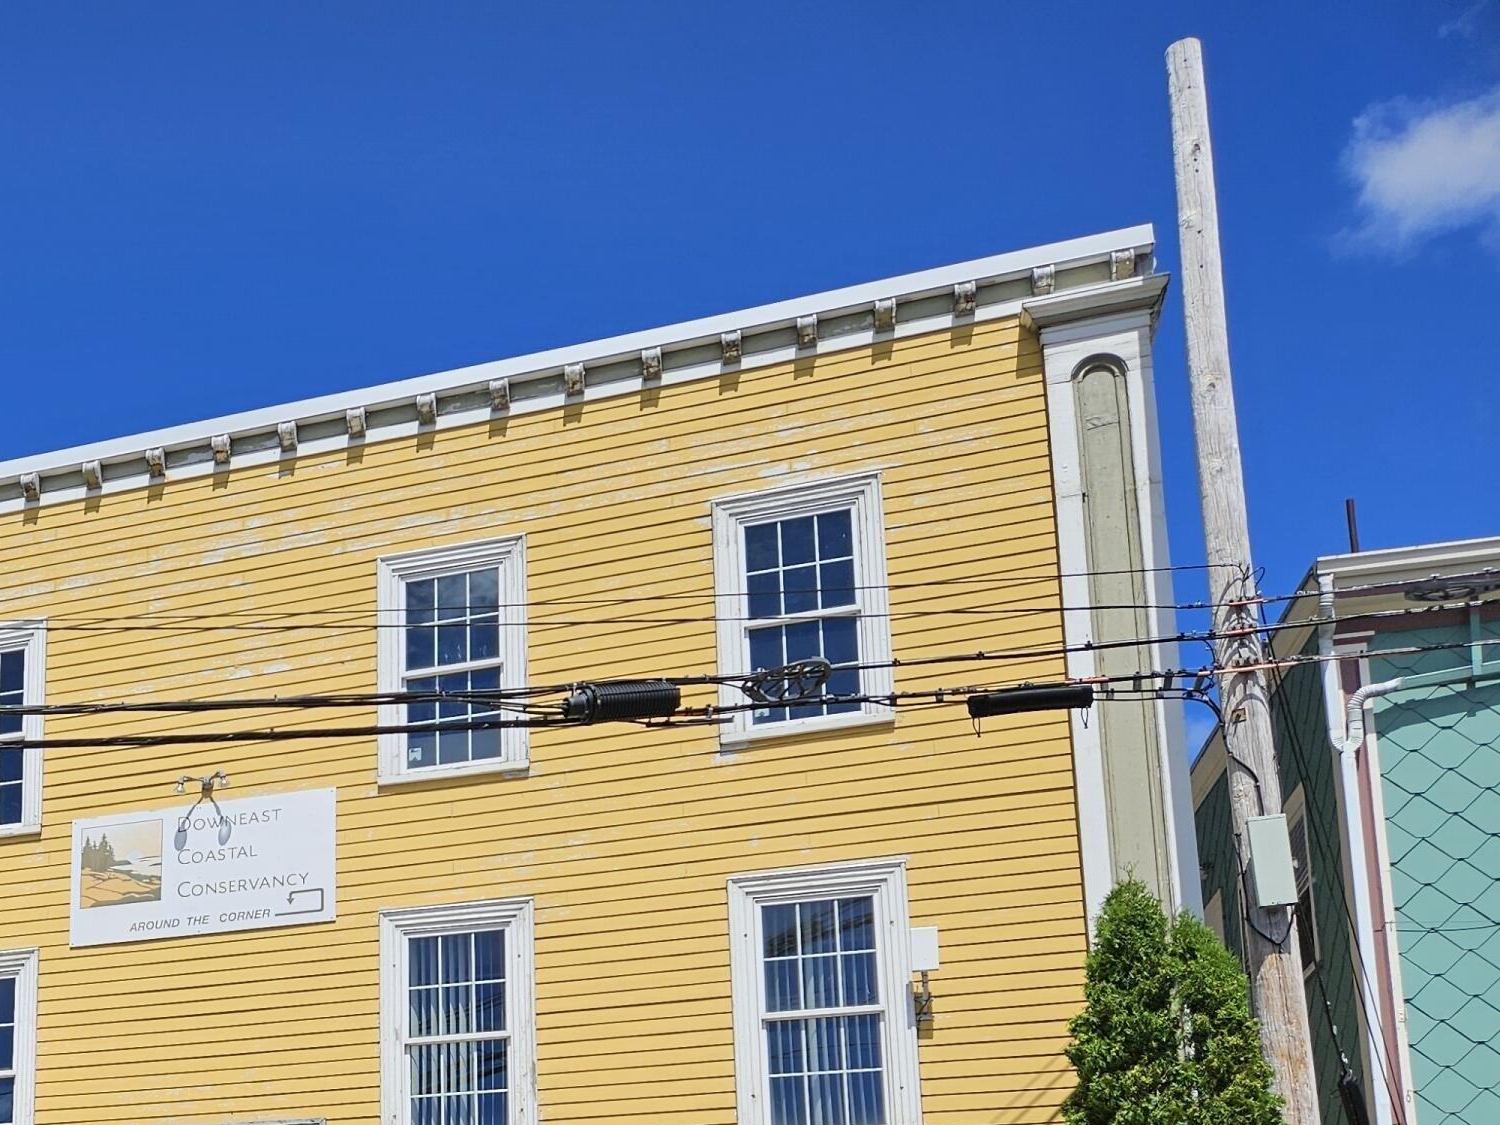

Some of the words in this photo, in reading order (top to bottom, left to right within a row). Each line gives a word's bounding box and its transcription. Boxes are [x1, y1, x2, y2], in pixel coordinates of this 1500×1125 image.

[178, 808, 282, 833] DOWNEAST
[177, 845, 258, 865] COASTAL
[177, 872, 309, 898] CONSERVANCY
[130, 918, 180, 932] AROUND
[187, 915, 210, 927] THE
[219, 909, 270, 922] CORNER
